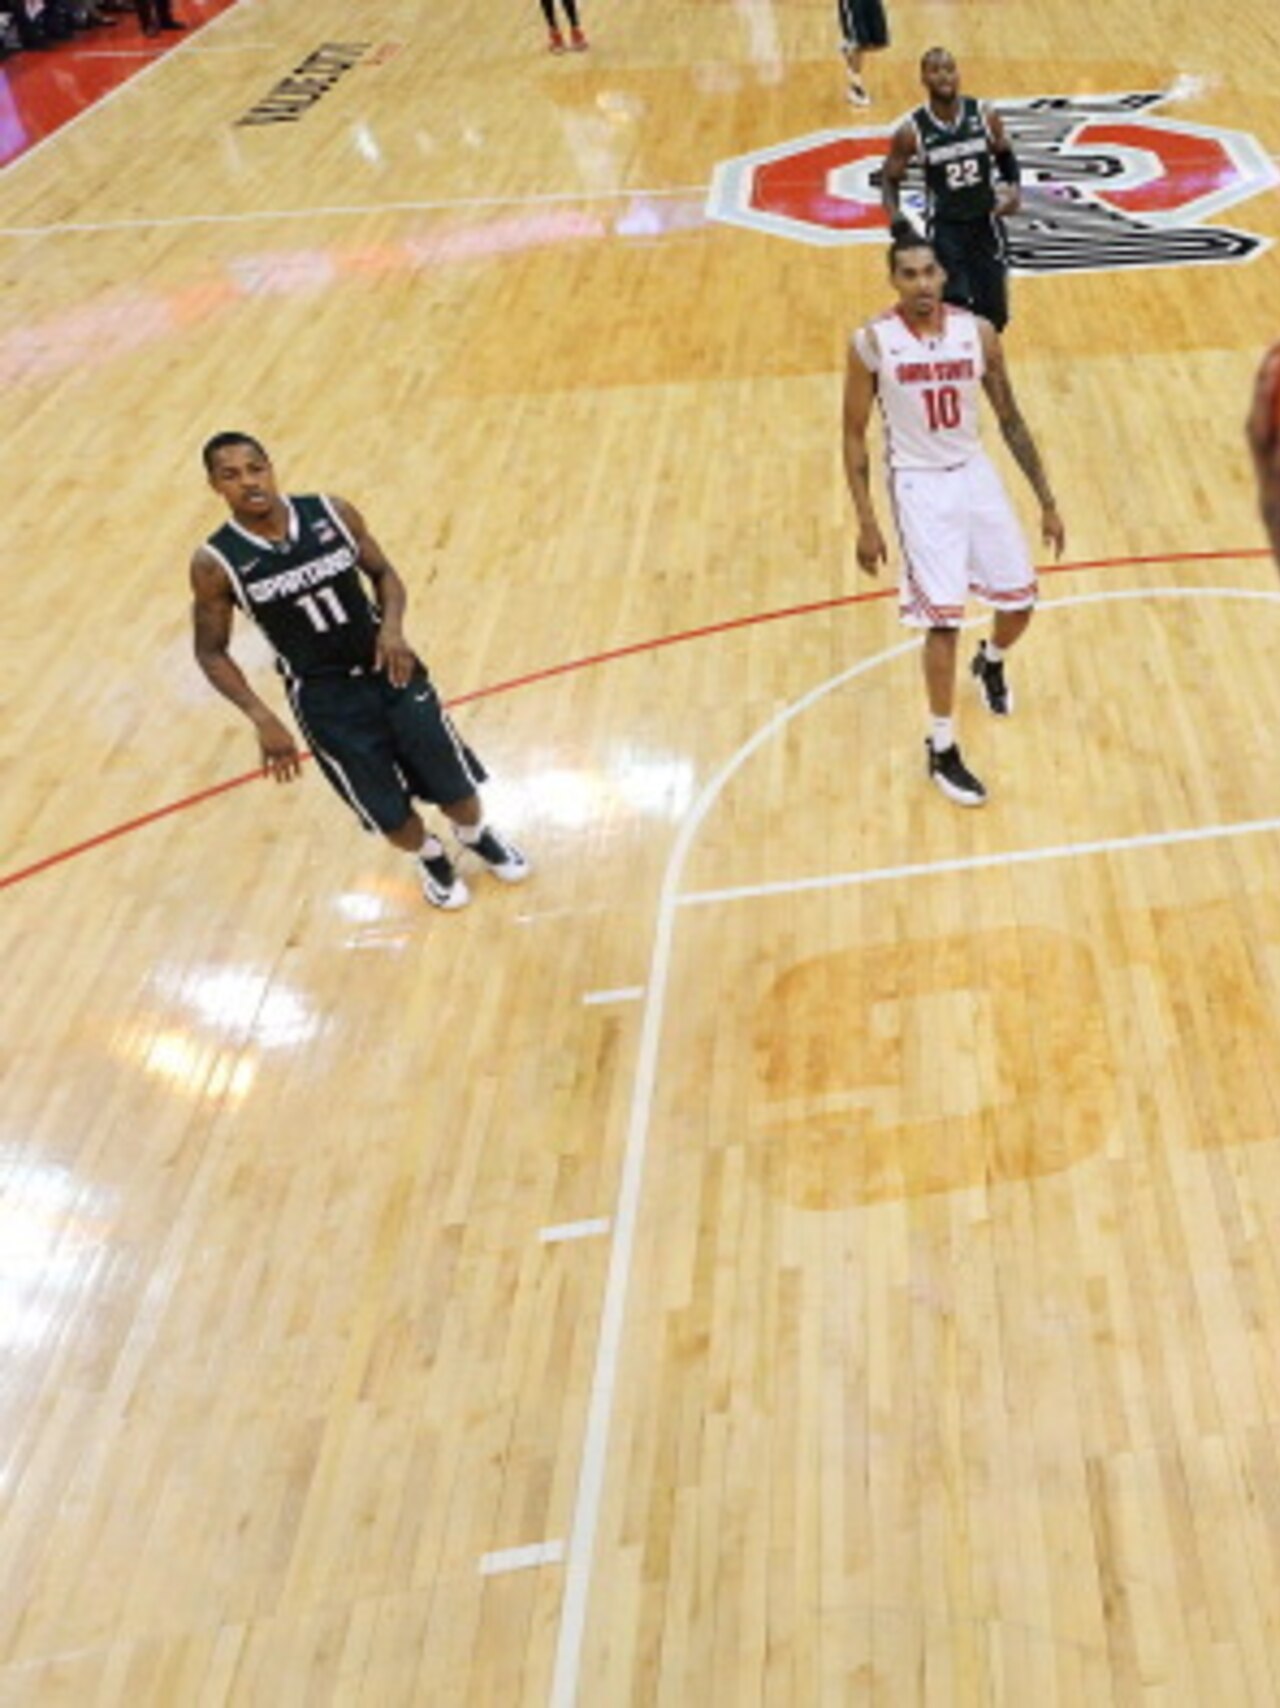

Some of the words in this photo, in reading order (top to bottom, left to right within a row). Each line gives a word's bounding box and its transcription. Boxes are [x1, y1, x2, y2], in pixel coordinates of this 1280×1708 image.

[946, 160, 981, 190] 22
[921, 385, 960, 431] 10
[295, 586, 348, 632] 11
